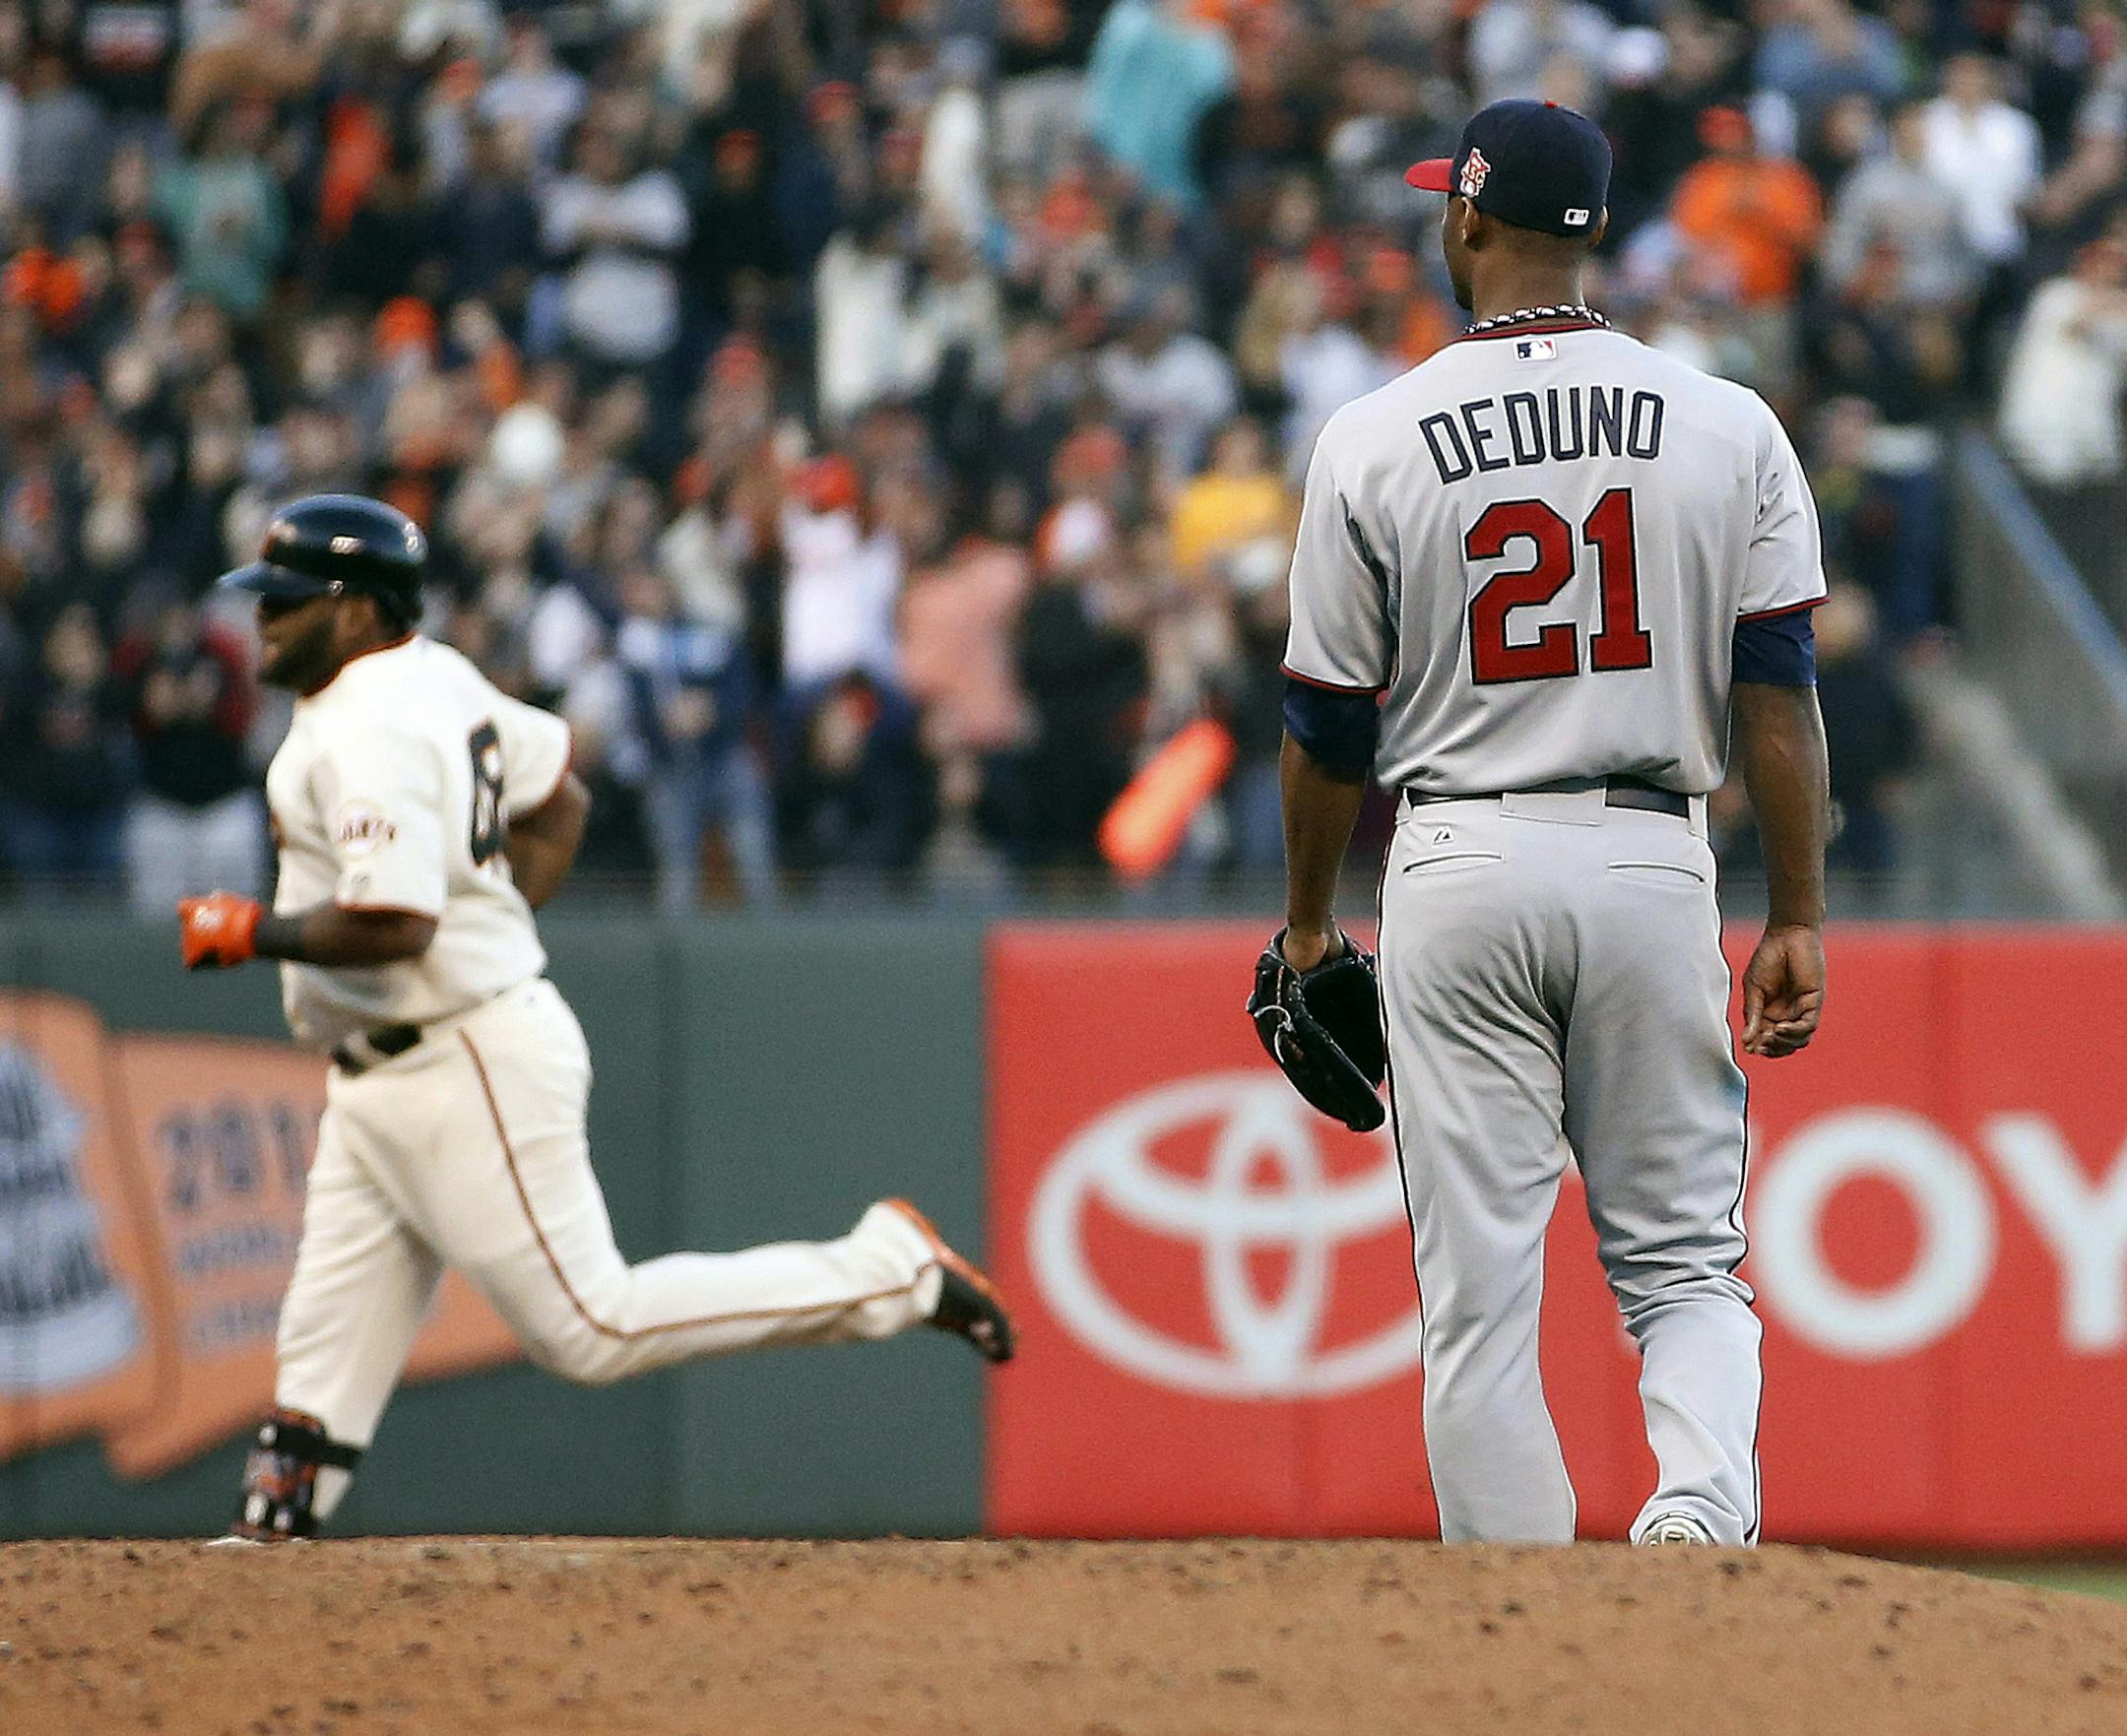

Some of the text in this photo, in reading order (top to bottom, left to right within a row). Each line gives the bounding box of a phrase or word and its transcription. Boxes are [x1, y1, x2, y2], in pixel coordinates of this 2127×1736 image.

[1419, 385, 1665, 485] DEDUNO
[1464, 486, 1653, 685] 21
[1564, 1105, 2127, 1361] OY
